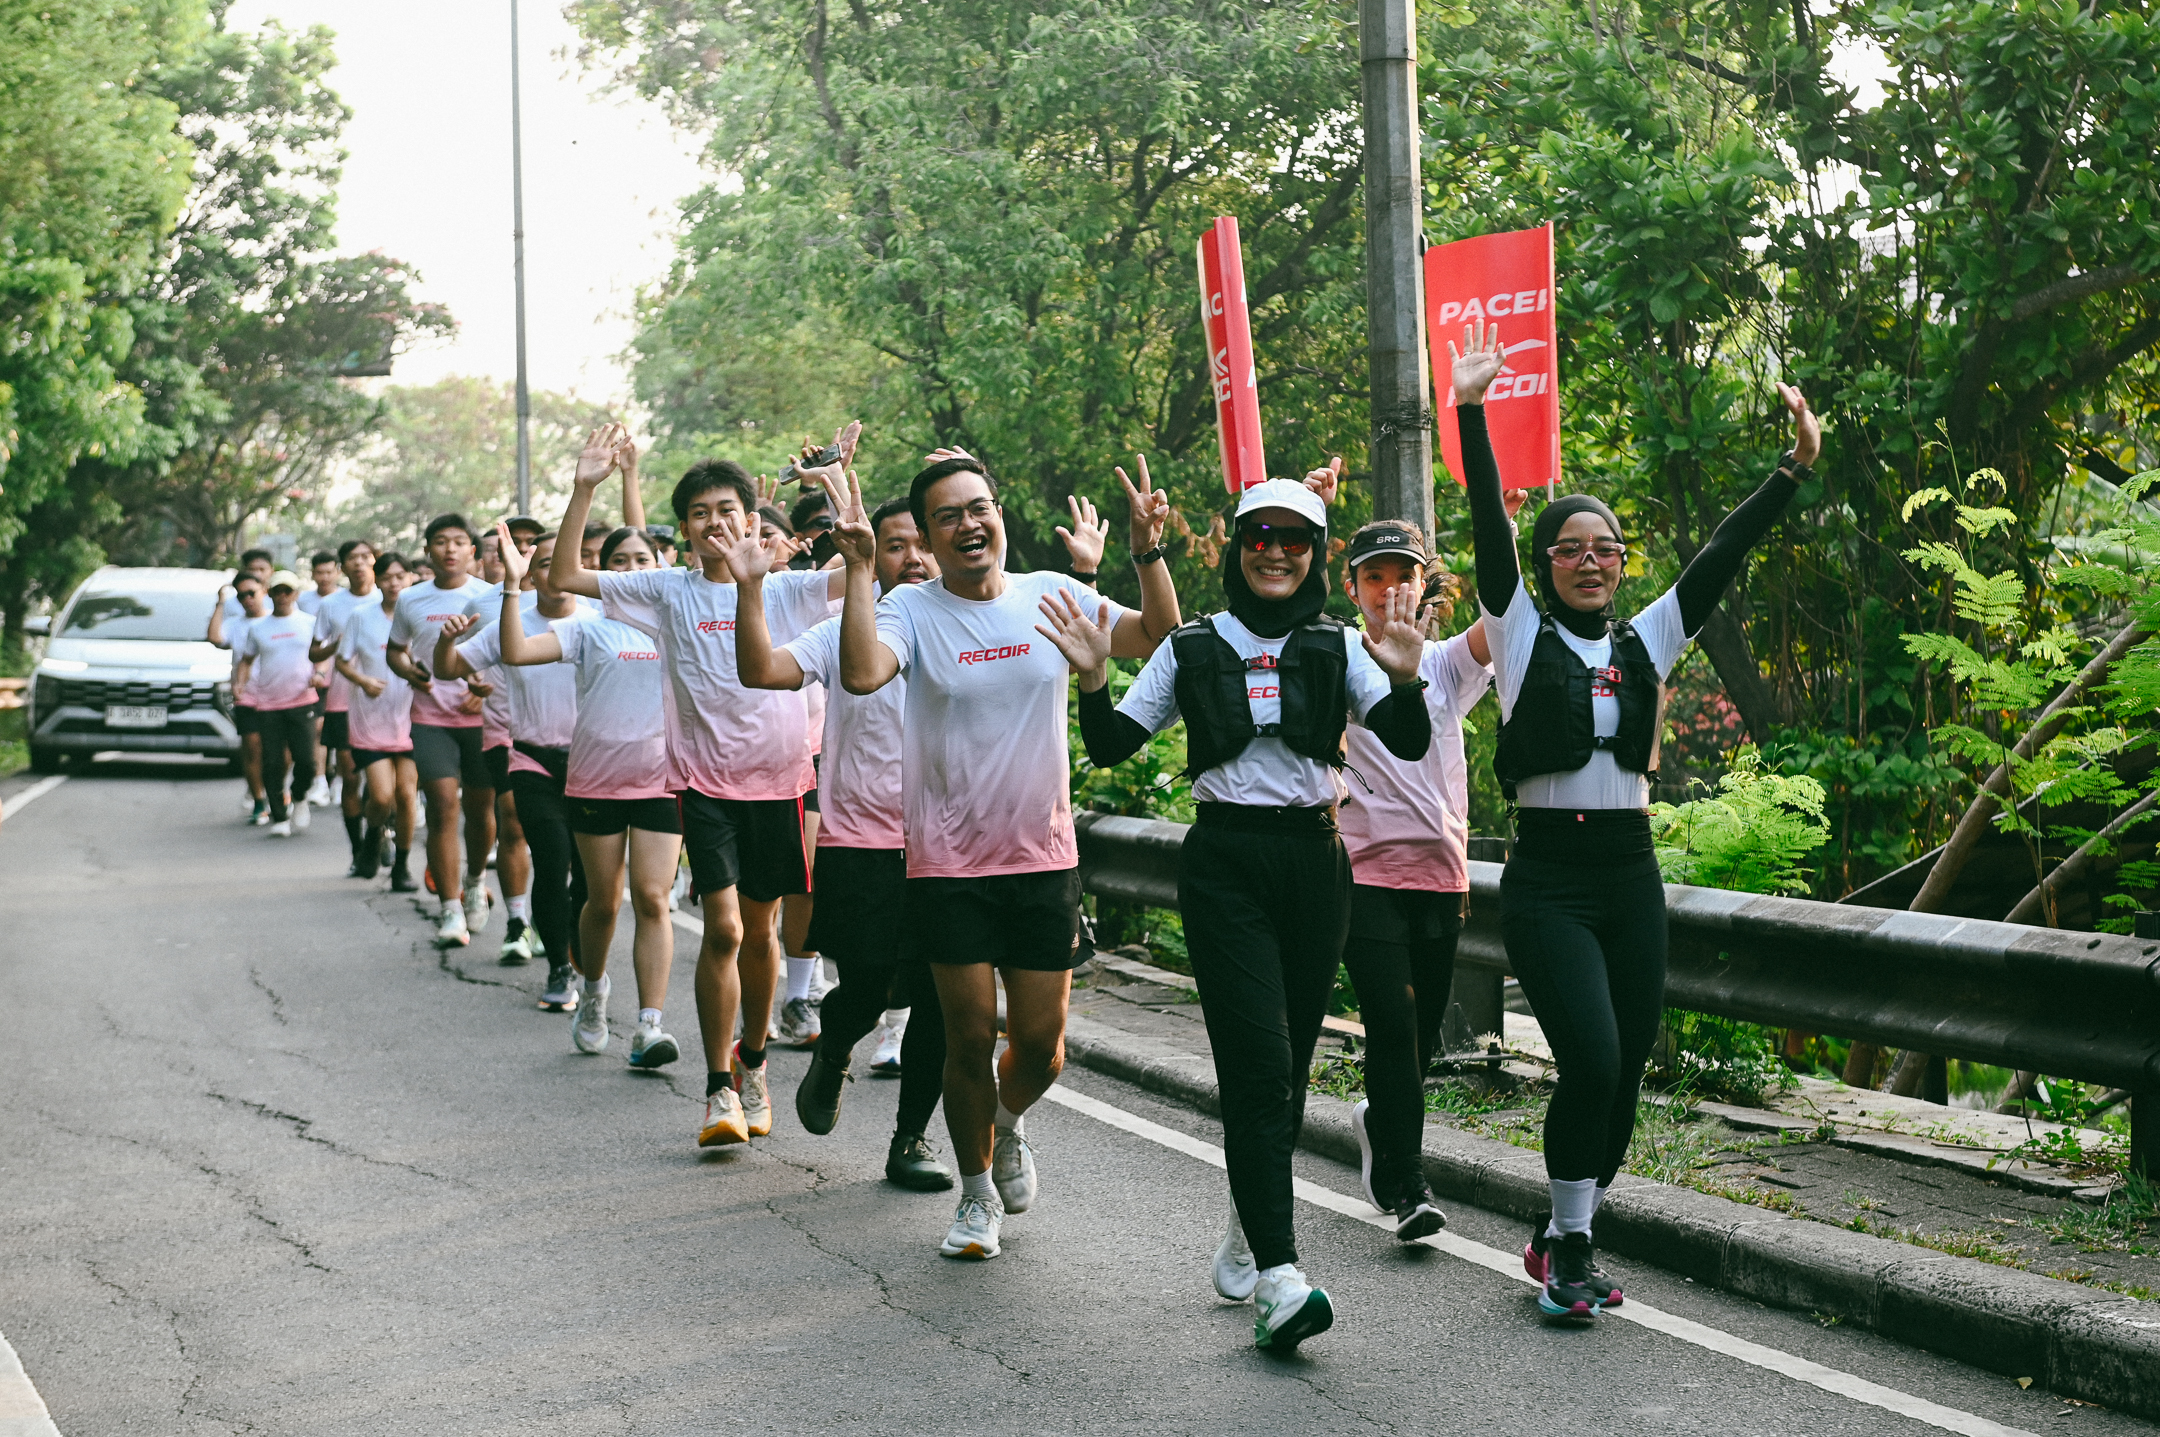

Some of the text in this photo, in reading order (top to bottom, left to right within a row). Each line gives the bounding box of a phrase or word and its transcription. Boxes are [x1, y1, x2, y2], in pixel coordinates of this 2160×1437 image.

[1376, 535, 1400, 544] SRC
[958, 643, 1031, 666] RECOIR
[1247, 686, 1282, 699] EC
